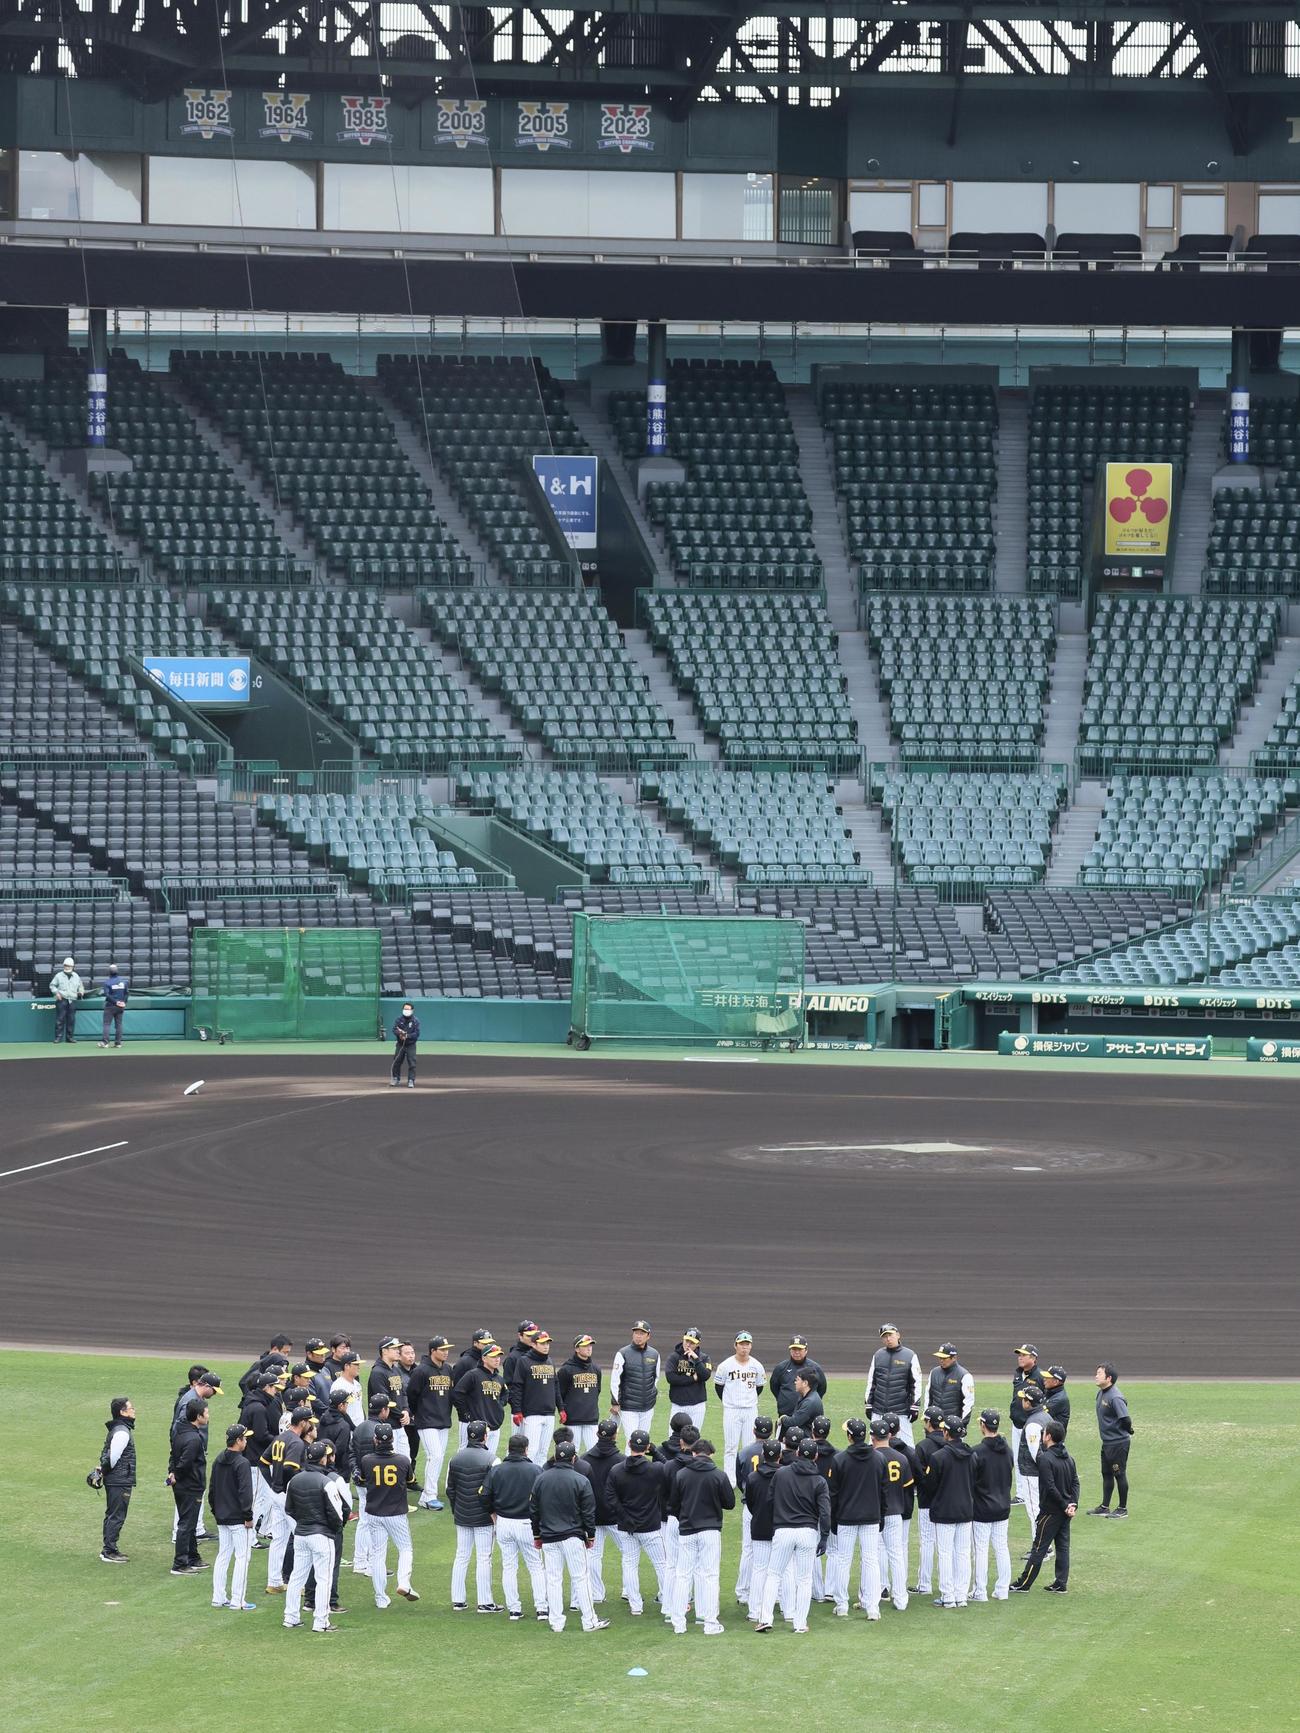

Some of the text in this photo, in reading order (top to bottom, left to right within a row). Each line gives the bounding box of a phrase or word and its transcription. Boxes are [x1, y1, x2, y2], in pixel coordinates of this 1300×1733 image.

[187, 101, 228, 121] 1962
[266, 105, 306, 125] 1964
[344, 108, 387, 129] 1985
[439, 111, 485, 131] 2003
[520, 114, 567, 134] 2005
[602, 116, 649, 136] 2023
[1233, 415, 1245, 453] 熊谷組
[169, 671, 224, 688] 毎日新聞
[807, 995, 869, 1012] ALINCO
[982, 992, 1013, 1002] エイジェック
[1041, 993, 1067, 1004] DTS
[1093, 995, 1125, 1004] エイジェック
[1153, 996, 1179, 1007] DTS
[1205, 998, 1237, 1008] エイジェック
[1266, 999, 1292, 1009] DTS
[1033, 1041, 1090, 1053] 損保ジャパン
[728, 1369, 759, 1381] Tigers
[372, 1464, 398, 1486] 16
[887, 1460, 901, 1482] 6
